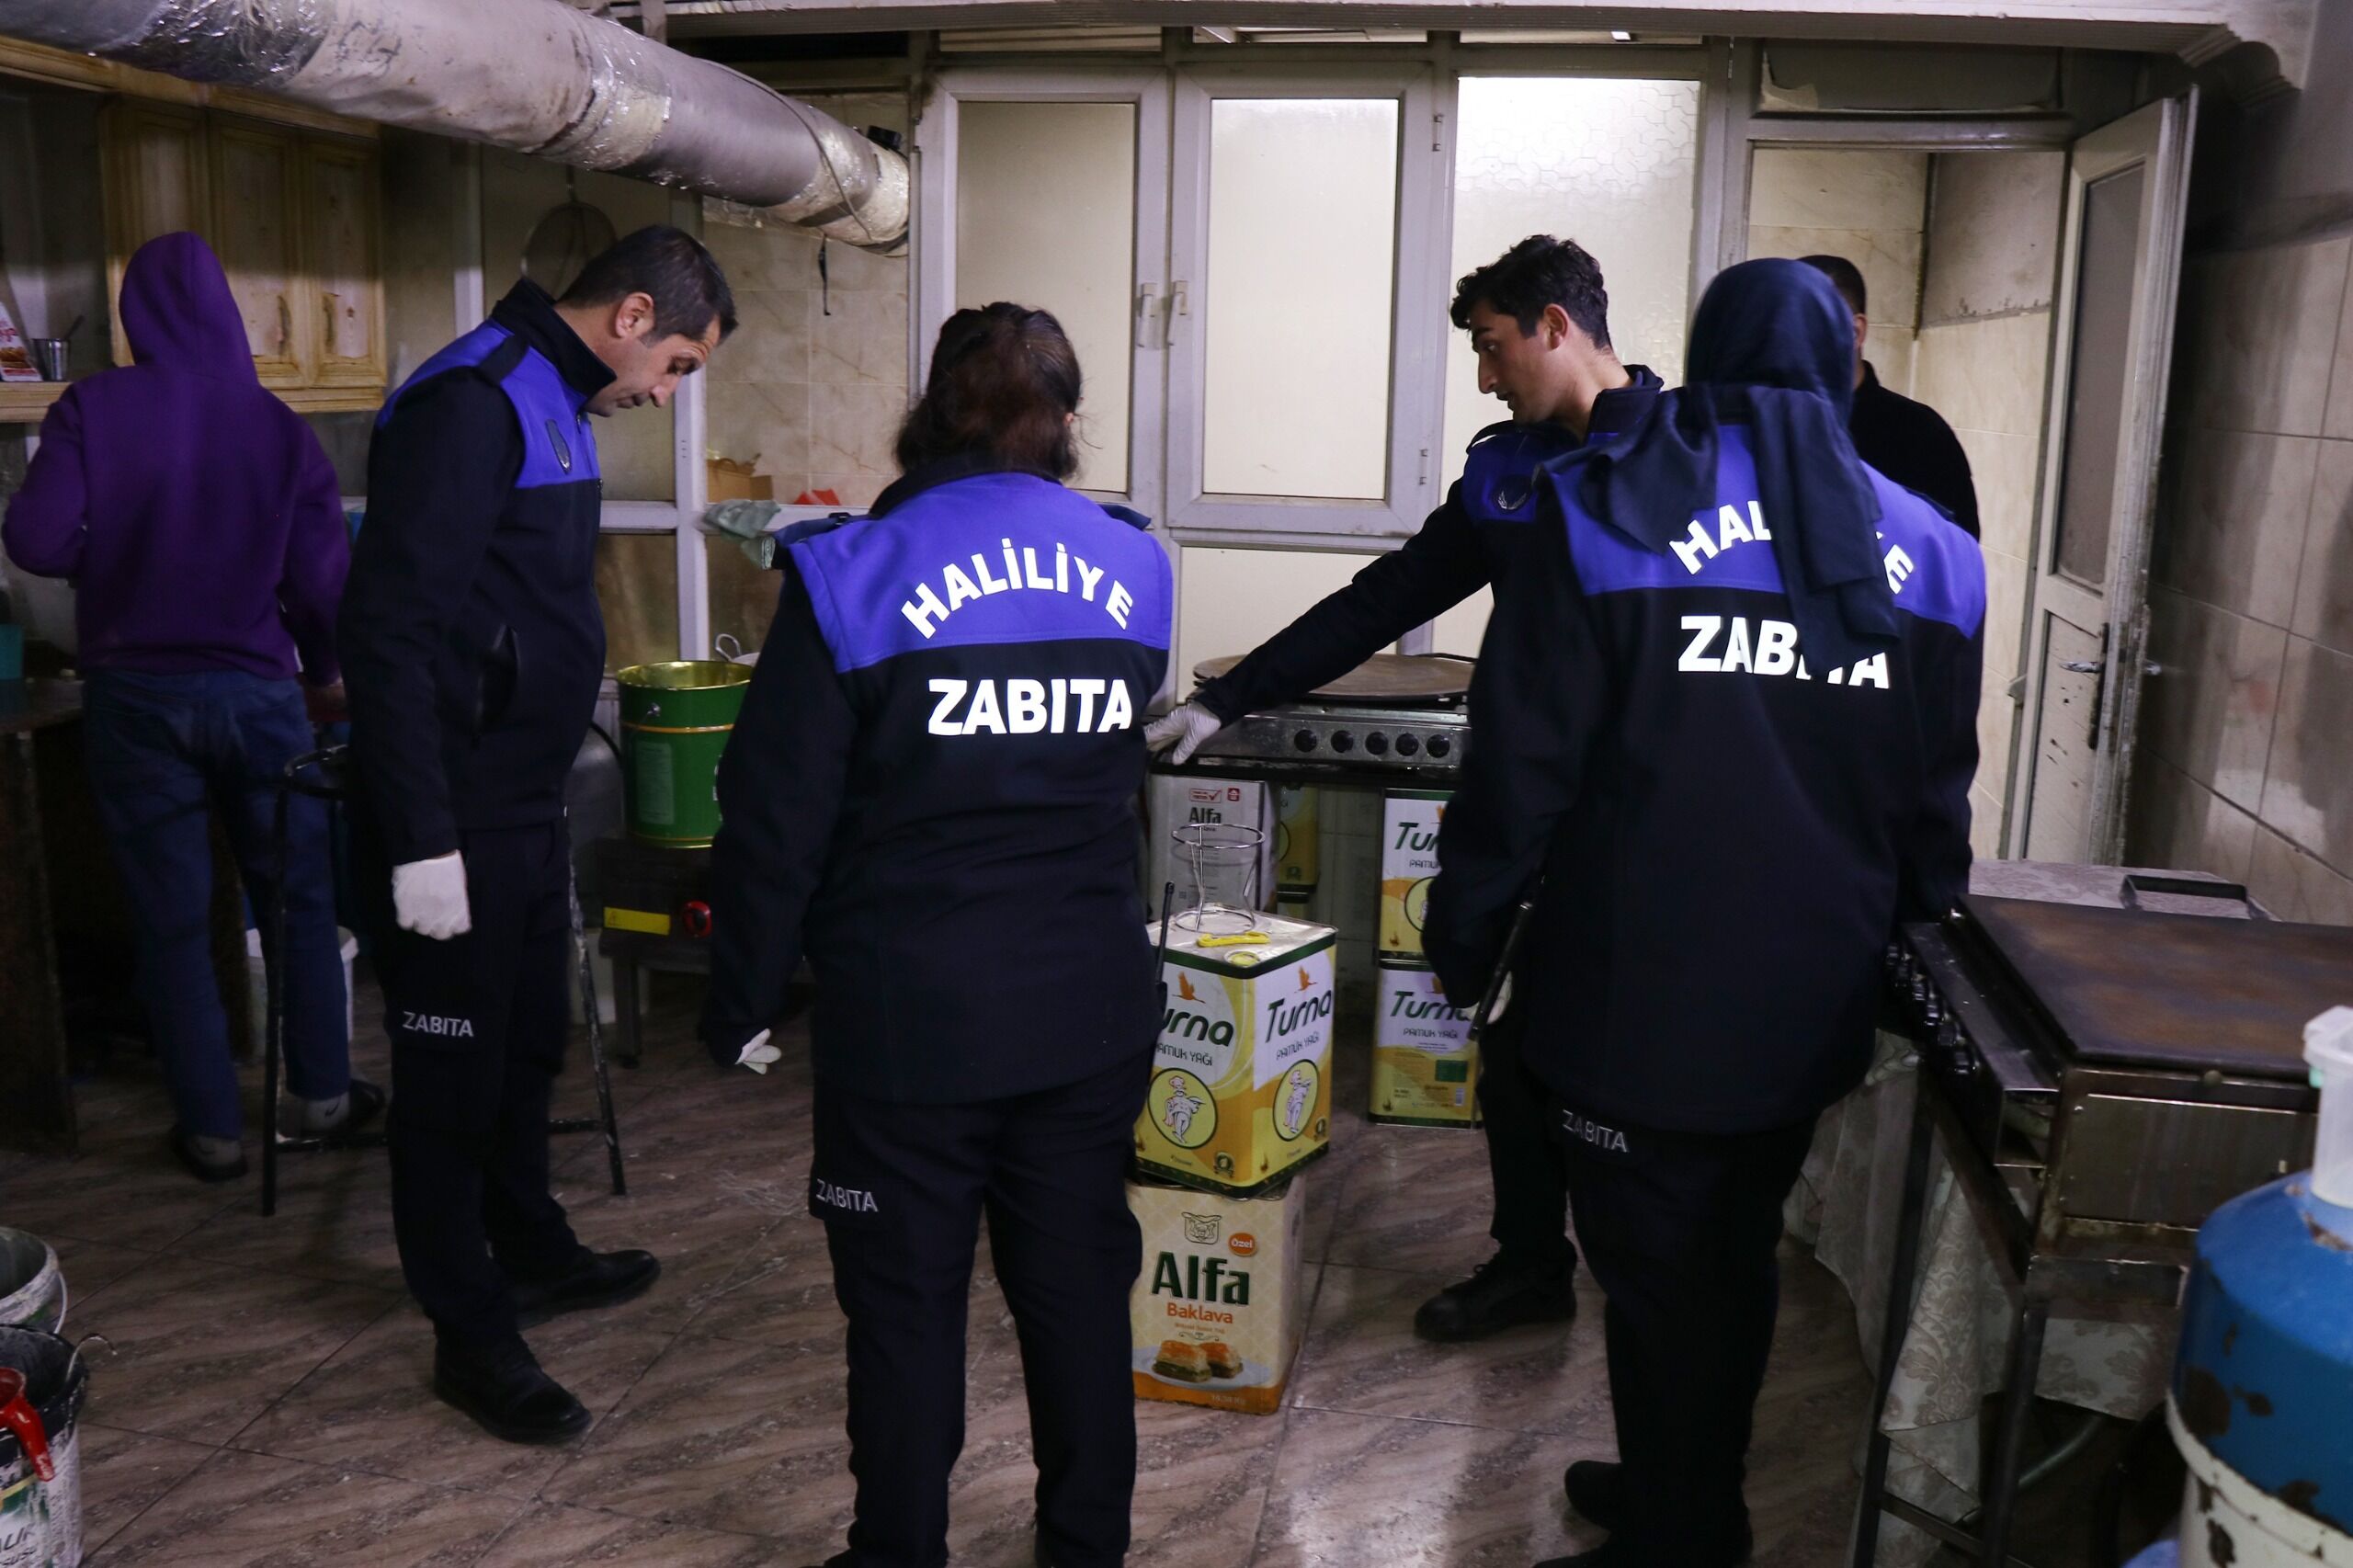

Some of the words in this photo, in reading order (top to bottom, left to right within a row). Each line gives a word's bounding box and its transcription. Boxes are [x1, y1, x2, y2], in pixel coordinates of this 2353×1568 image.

[901, 538, 1133, 639] HALİLİYE
[927, 678, 1132, 735] ZABITA
[1188, 807, 1222, 824] Alfa
[403, 1010, 474, 1038] ZABITA
[1265, 990, 1332, 1044] Turna
[1155, 1042, 1188, 1061] AMUK
[1563, 1108, 1629, 1153] ZABITA
[815, 1177, 879, 1212] ZABITA
[1151, 1251, 1250, 1306] Alfa
[1166, 1301, 1234, 1324] Baklava
